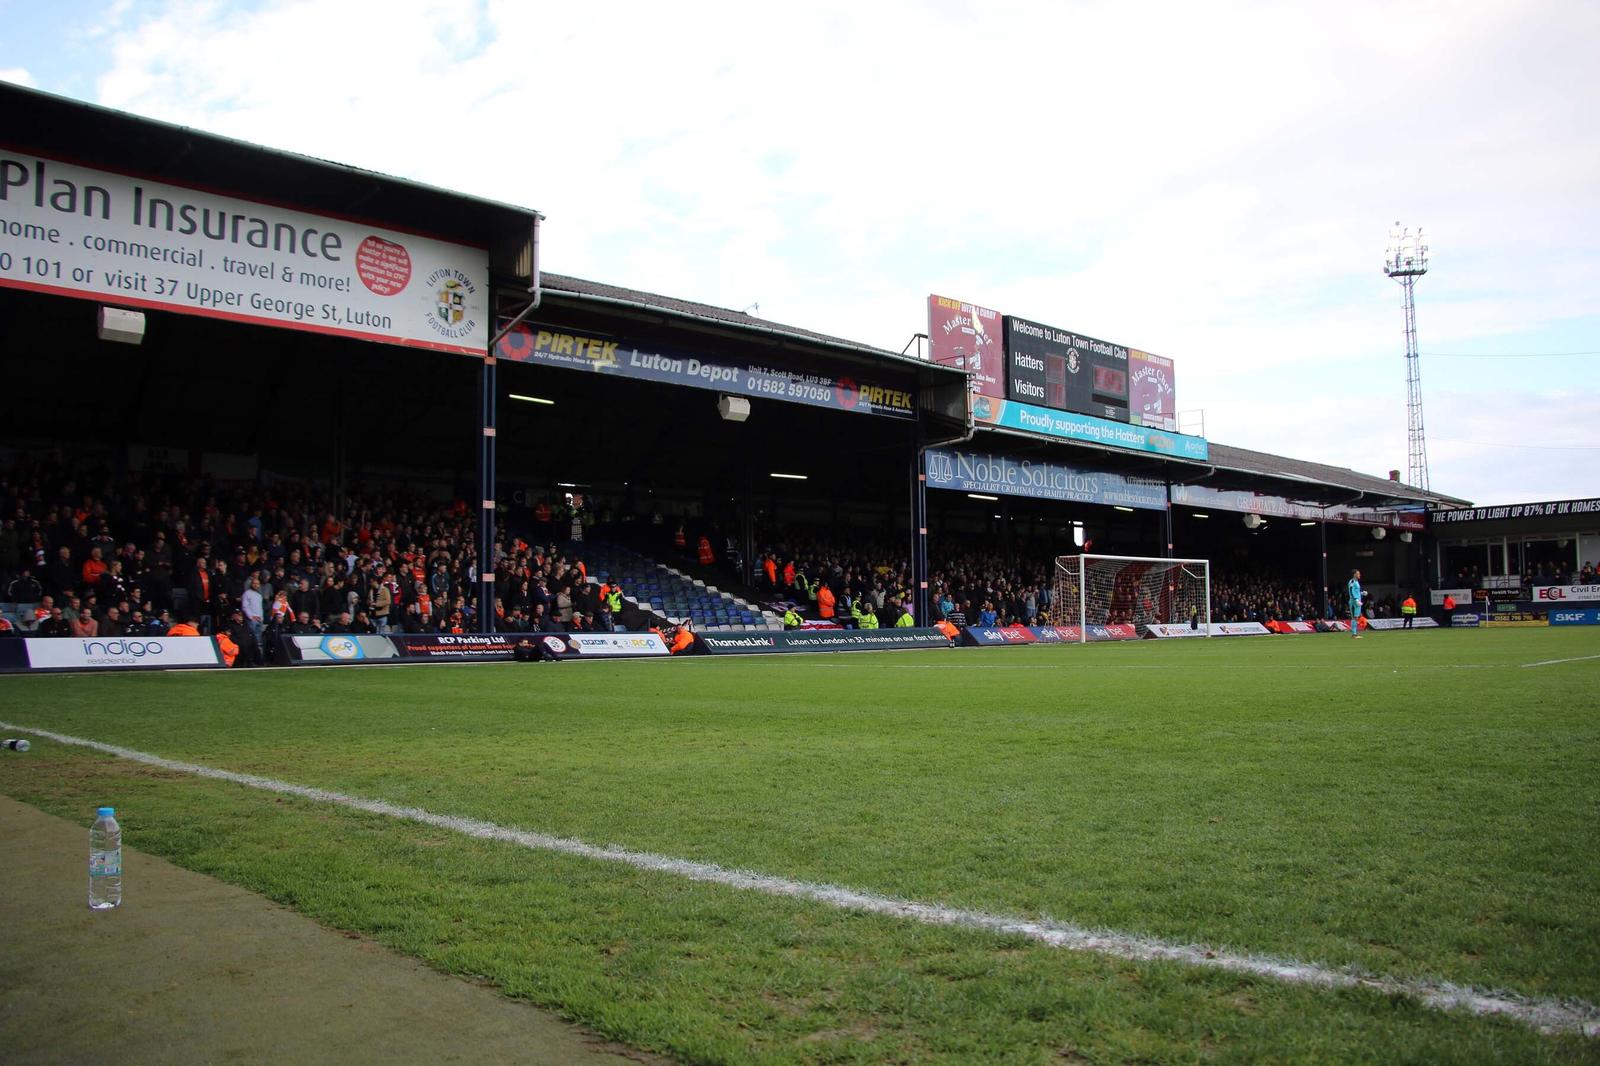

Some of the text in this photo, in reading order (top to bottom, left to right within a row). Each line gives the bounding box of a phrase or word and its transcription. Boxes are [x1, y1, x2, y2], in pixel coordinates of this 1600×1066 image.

[0, 159, 342, 262] Plan Insurance
[83, 235, 203, 268] commercial
[223, 256, 274, 280] travel
[281, 267, 294, 283] &
[300, 272, 350, 293] more!
[426, 268, 476, 294] LUTON TOWN
[22, 256, 62, 279] 101
[72, 267, 94, 284] or
[105, 269, 148, 293] visit
[154, 277, 179, 297] 37
[186, 282, 244, 307] Upper
[250, 293, 315, 320] George
[346, 307, 392, 329] Luton
[425, 312, 476, 338] FOOTBALL CLUB
[943, 315, 972, 335] Master
[534, 330, 619, 362] PIRTEK
[1012, 319, 1043, 338] Welcome
[1044, 331, 1051, 340] to
[1053, 330, 1071, 344] Luton
[1072, 335, 1089, 350] Town
[1090, 340, 1113, 356] Football
[1114, 346, 1127, 360] Club
[630, 349, 739, 382] Luton Depot
[748, 365, 762, 375] Unit
[770, 369, 787, 380] Scott
[1014, 352, 1044, 371] Hatters
[1131, 366, 1155, 387] Master
[747, 377, 831, 402] 01582 597050
[859, 385, 912, 409] PIRTEK
[1014, 379, 1045, 398] Visitors
[1020, 410, 1145, 445] Proudly supporting the Hatters
[954, 452, 1017, 485] Noble
[1021, 459, 1099, 494] Solicitors
[963, 480, 1000, 492] SPECIALIST
[1001, 484, 1036, 496] CRIMINAL
[1432, 499, 1600, 523] THE POWER TO LIGHT UP 87% OF UK HOMES
[1555, 613, 1585, 622] SKF
[438, 636, 456, 644] RCP
[457, 636, 491, 645] Parking
[785, 638, 810, 646] Luton
[820, 637, 847, 645] London
[866, 635, 892, 643] minutes
[983, 628, 1025, 641] sky bet
[1041, 628, 1080, 640] sky bet
[1093, 627, 1127, 638] sky bet
[83, 639, 163, 657] indigo
